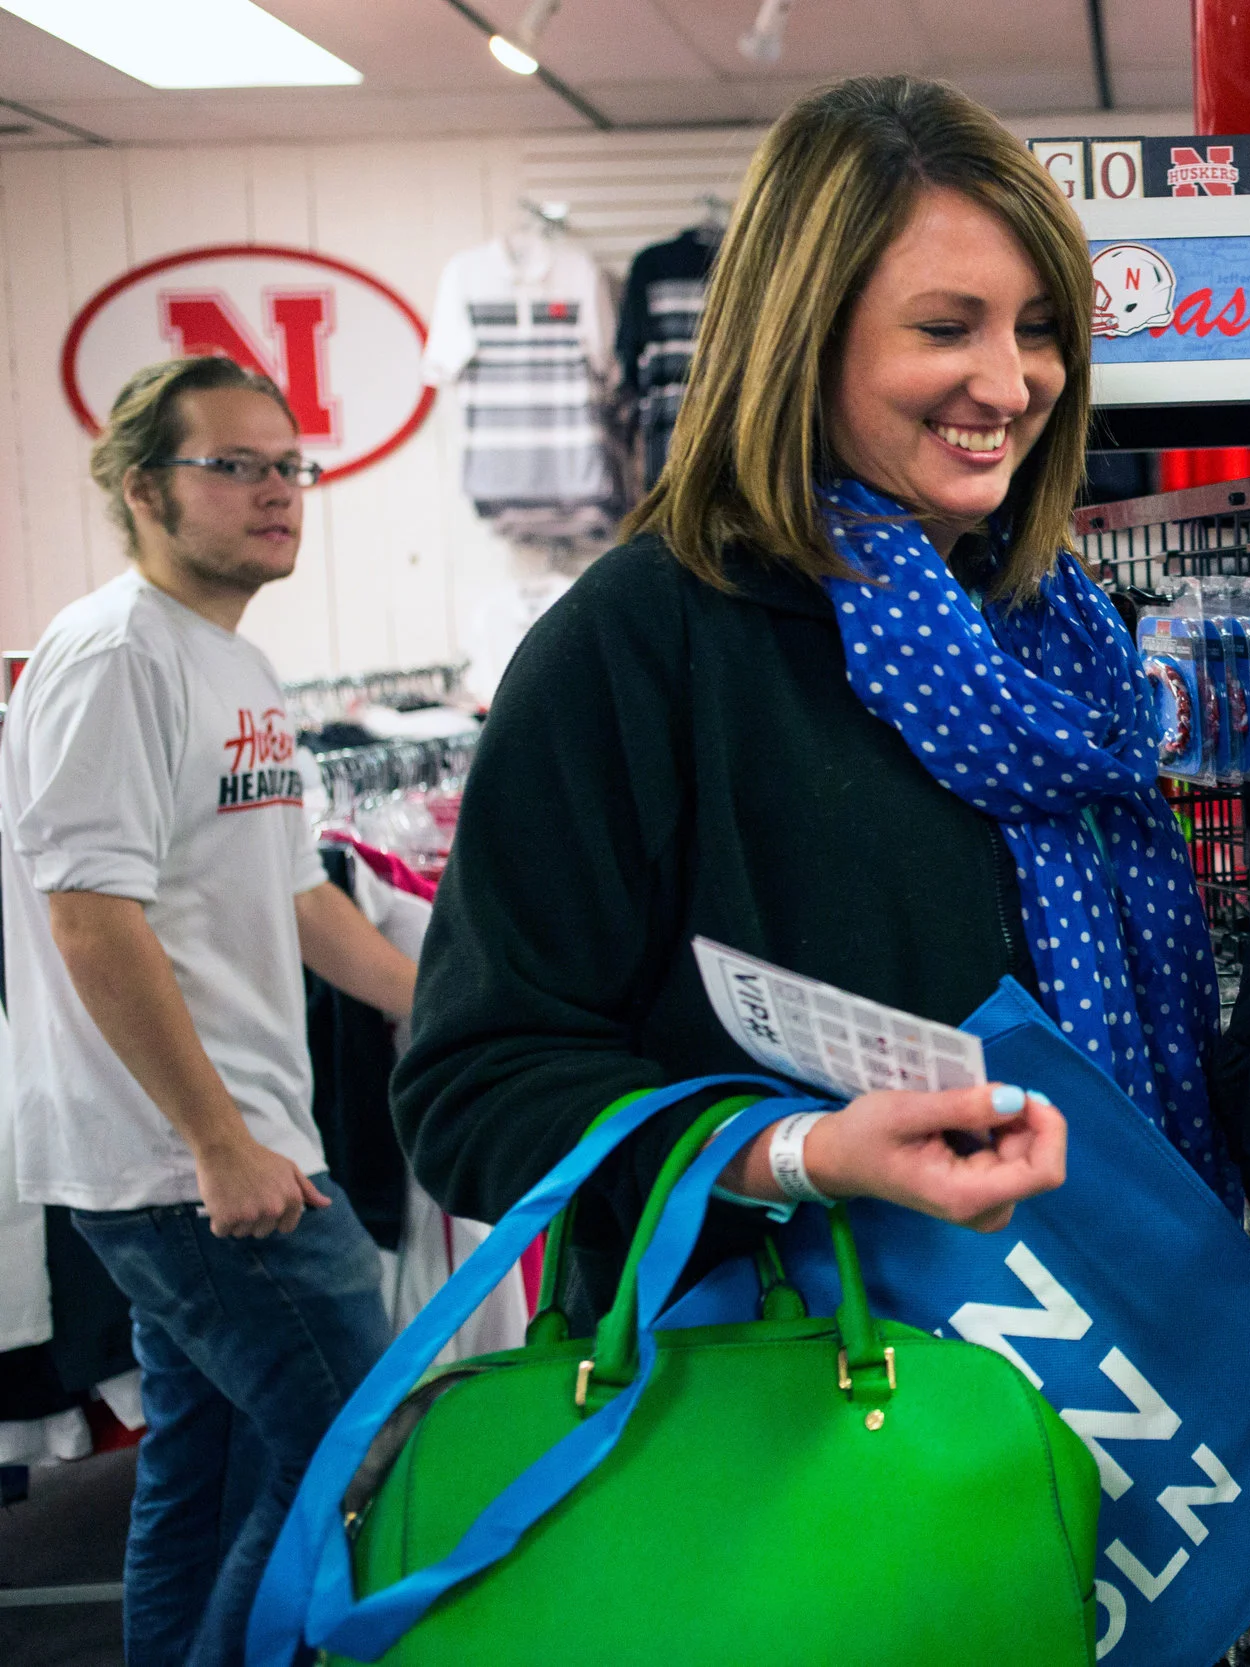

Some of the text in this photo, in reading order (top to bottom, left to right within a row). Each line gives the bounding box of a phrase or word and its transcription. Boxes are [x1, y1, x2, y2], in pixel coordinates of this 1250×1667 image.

[1169, 168, 1238, 184] HUSKERS
[1125, 267, 1141, 290] N
[157, 287, 341, 446] N
